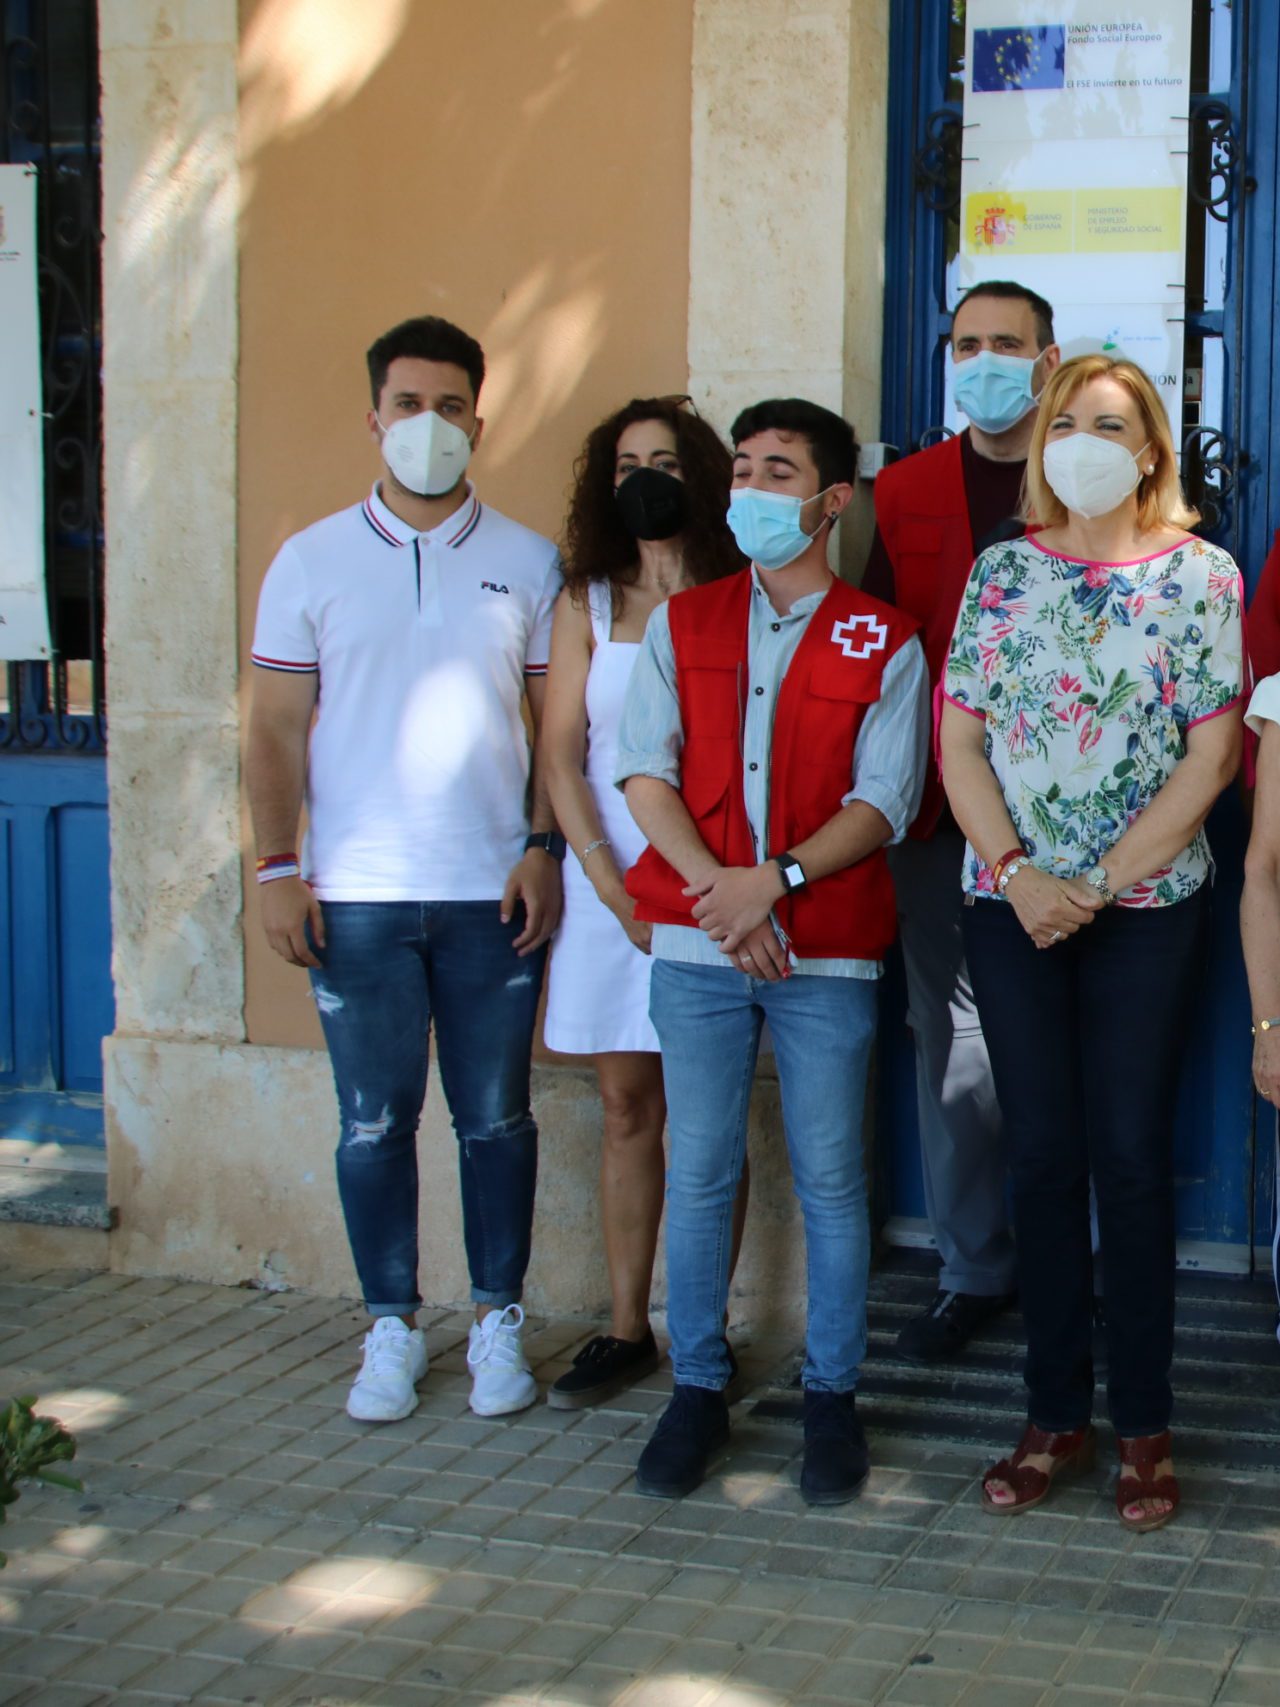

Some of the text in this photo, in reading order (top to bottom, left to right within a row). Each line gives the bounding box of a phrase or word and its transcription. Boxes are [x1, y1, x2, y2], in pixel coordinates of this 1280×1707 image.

[1067, 22, 1143, 34] UNIÓN EUROPEA
[1067, 33, 1162, 44] Fondo Social Europeo
[1066, 80, 1074, 89] El
[1076, 79, 1091, 88] FSE
[1093, 79, 1127, 88] invierte
[1142, 78, 1153, 87] tu
[1154, 77, 1182, 87] futuro
[481, 580, 509, 594] FILA
